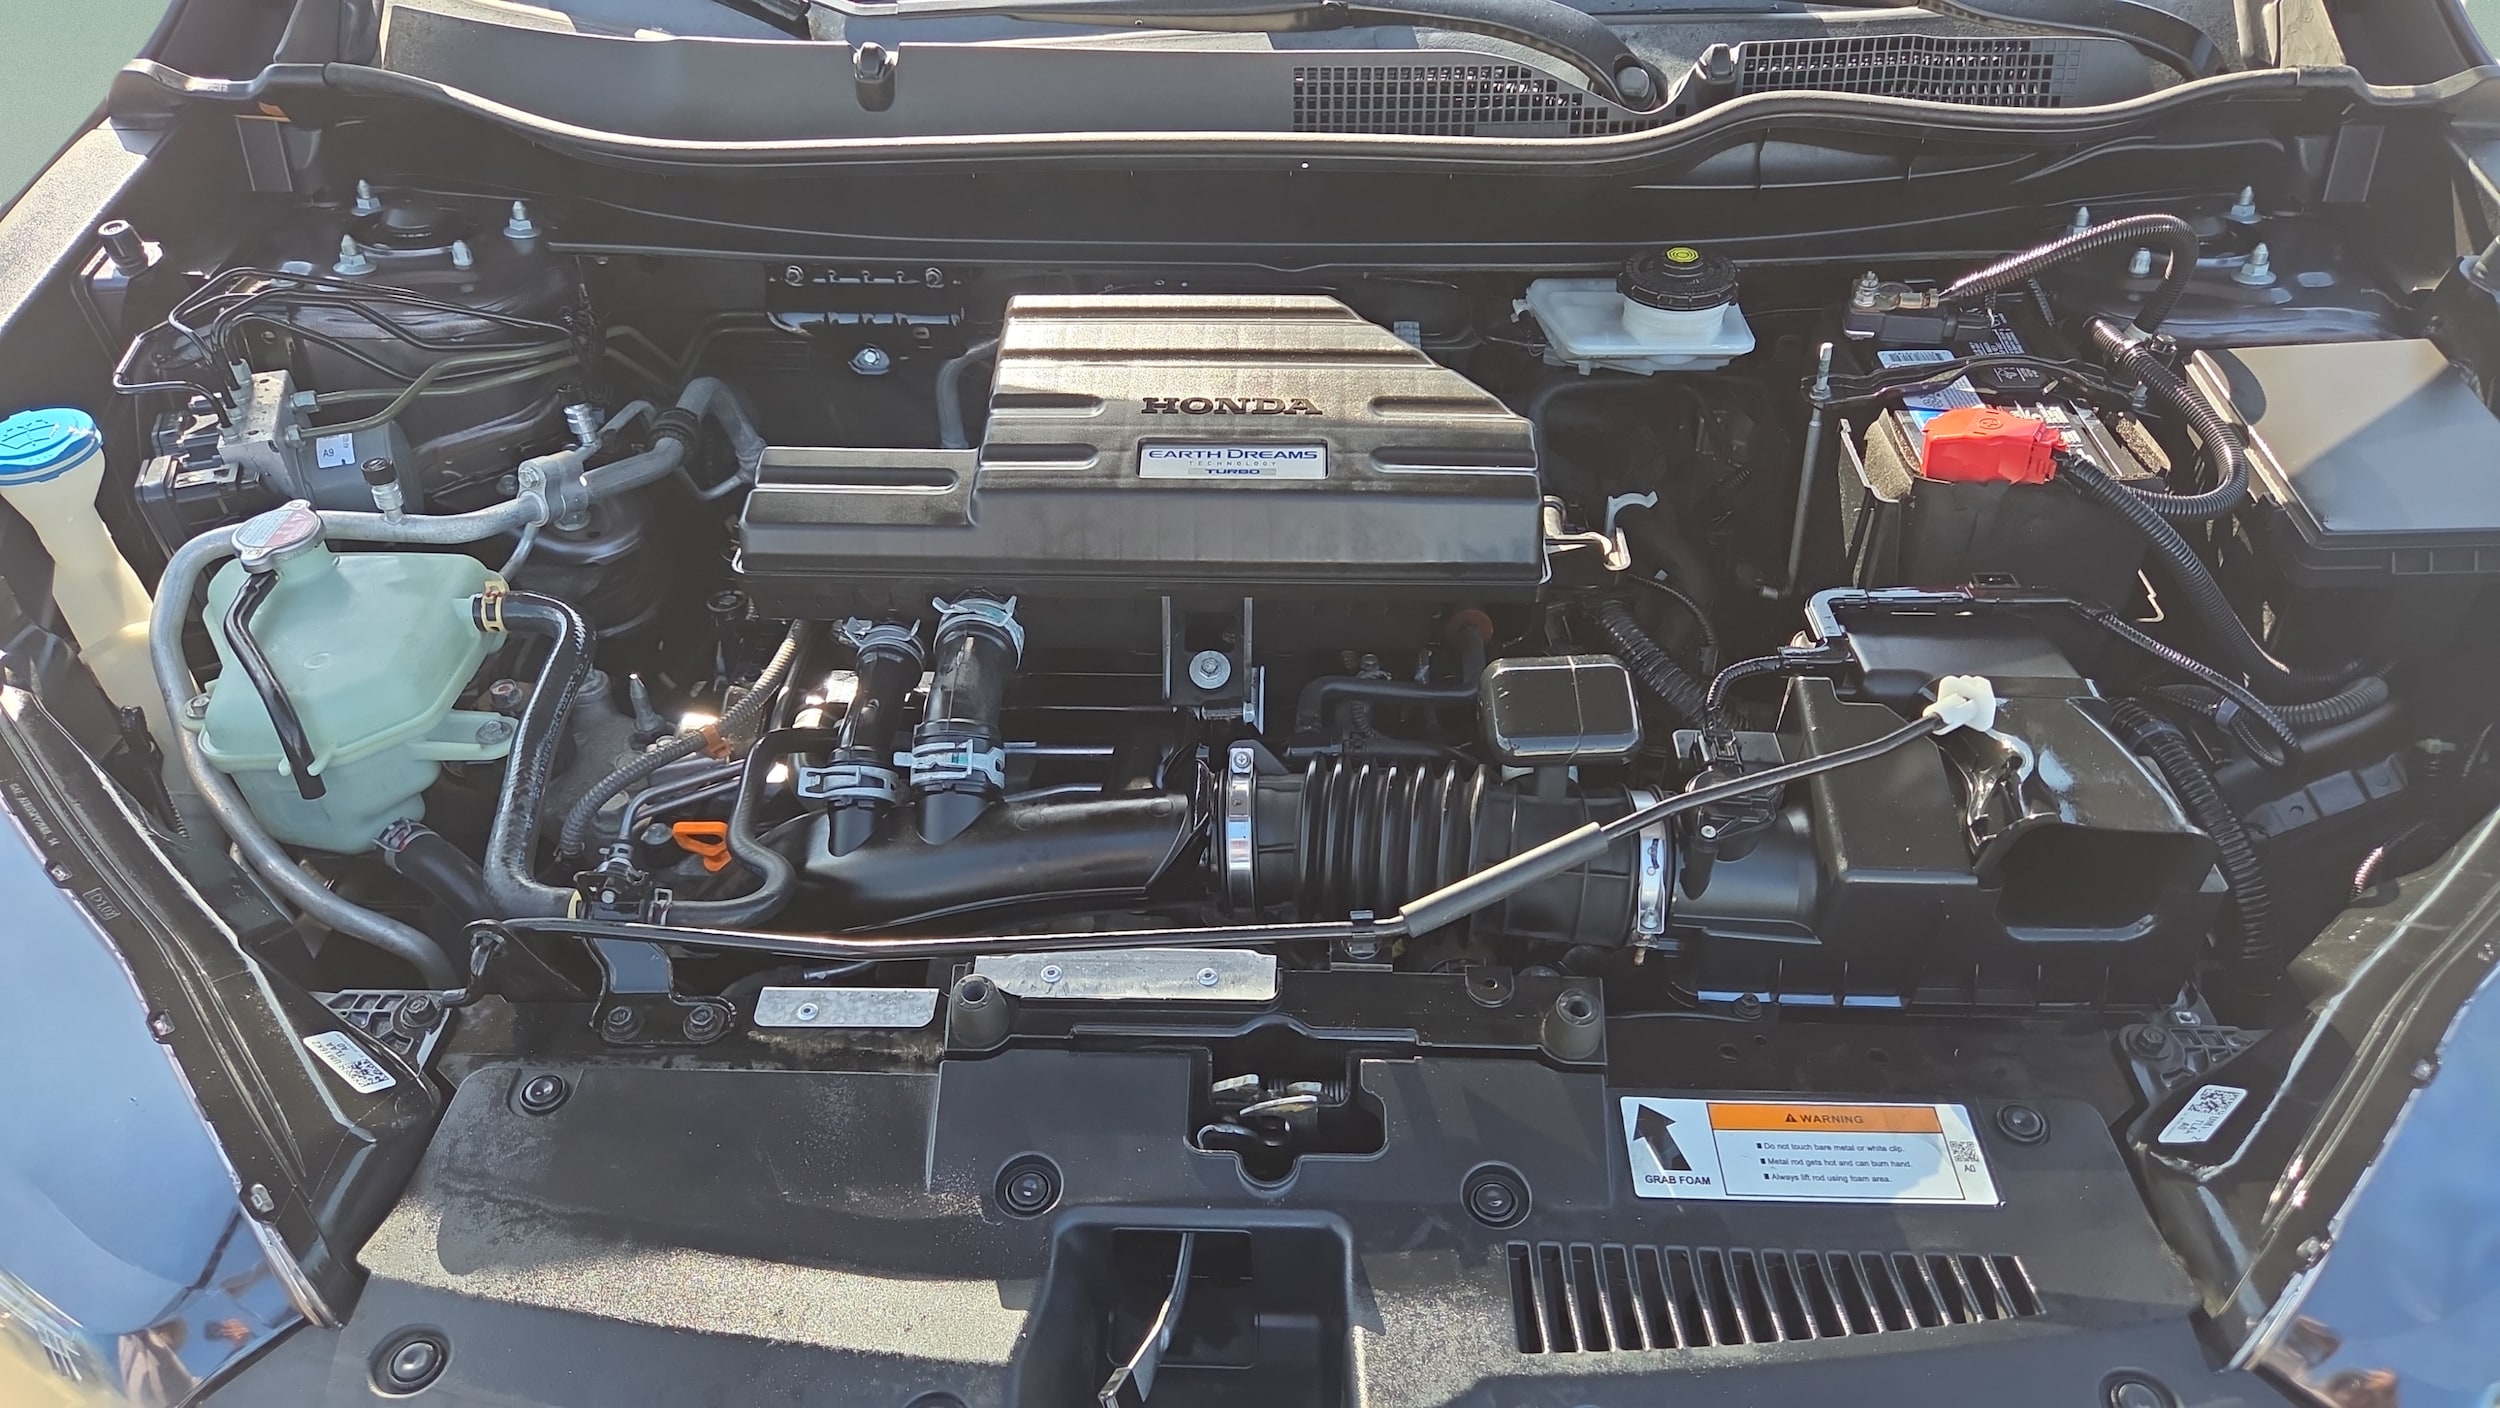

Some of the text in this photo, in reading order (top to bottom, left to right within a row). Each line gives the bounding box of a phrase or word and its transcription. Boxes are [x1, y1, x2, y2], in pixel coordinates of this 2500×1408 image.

[1141, 397, 1323, 415] HONDA
[323, 448, 335, 458] A9
[1149, 449, 1318, 459] EARTH DREAMS
[1800, 1114, 1864, 1124] WARNING
[1791, 1143, 1812, 1151] touch
[1889, 1145, 1905, 1153] clip.
[1806, 1159, 1822, 1167] gets
[1890, 1160, 1913, 1168] hand.
[1645, 1175, 1711, 1185] GRAB FOAM
[1771, 1173, 1799, 1182] Always
[1827, 1175, 1848, 1183] using
